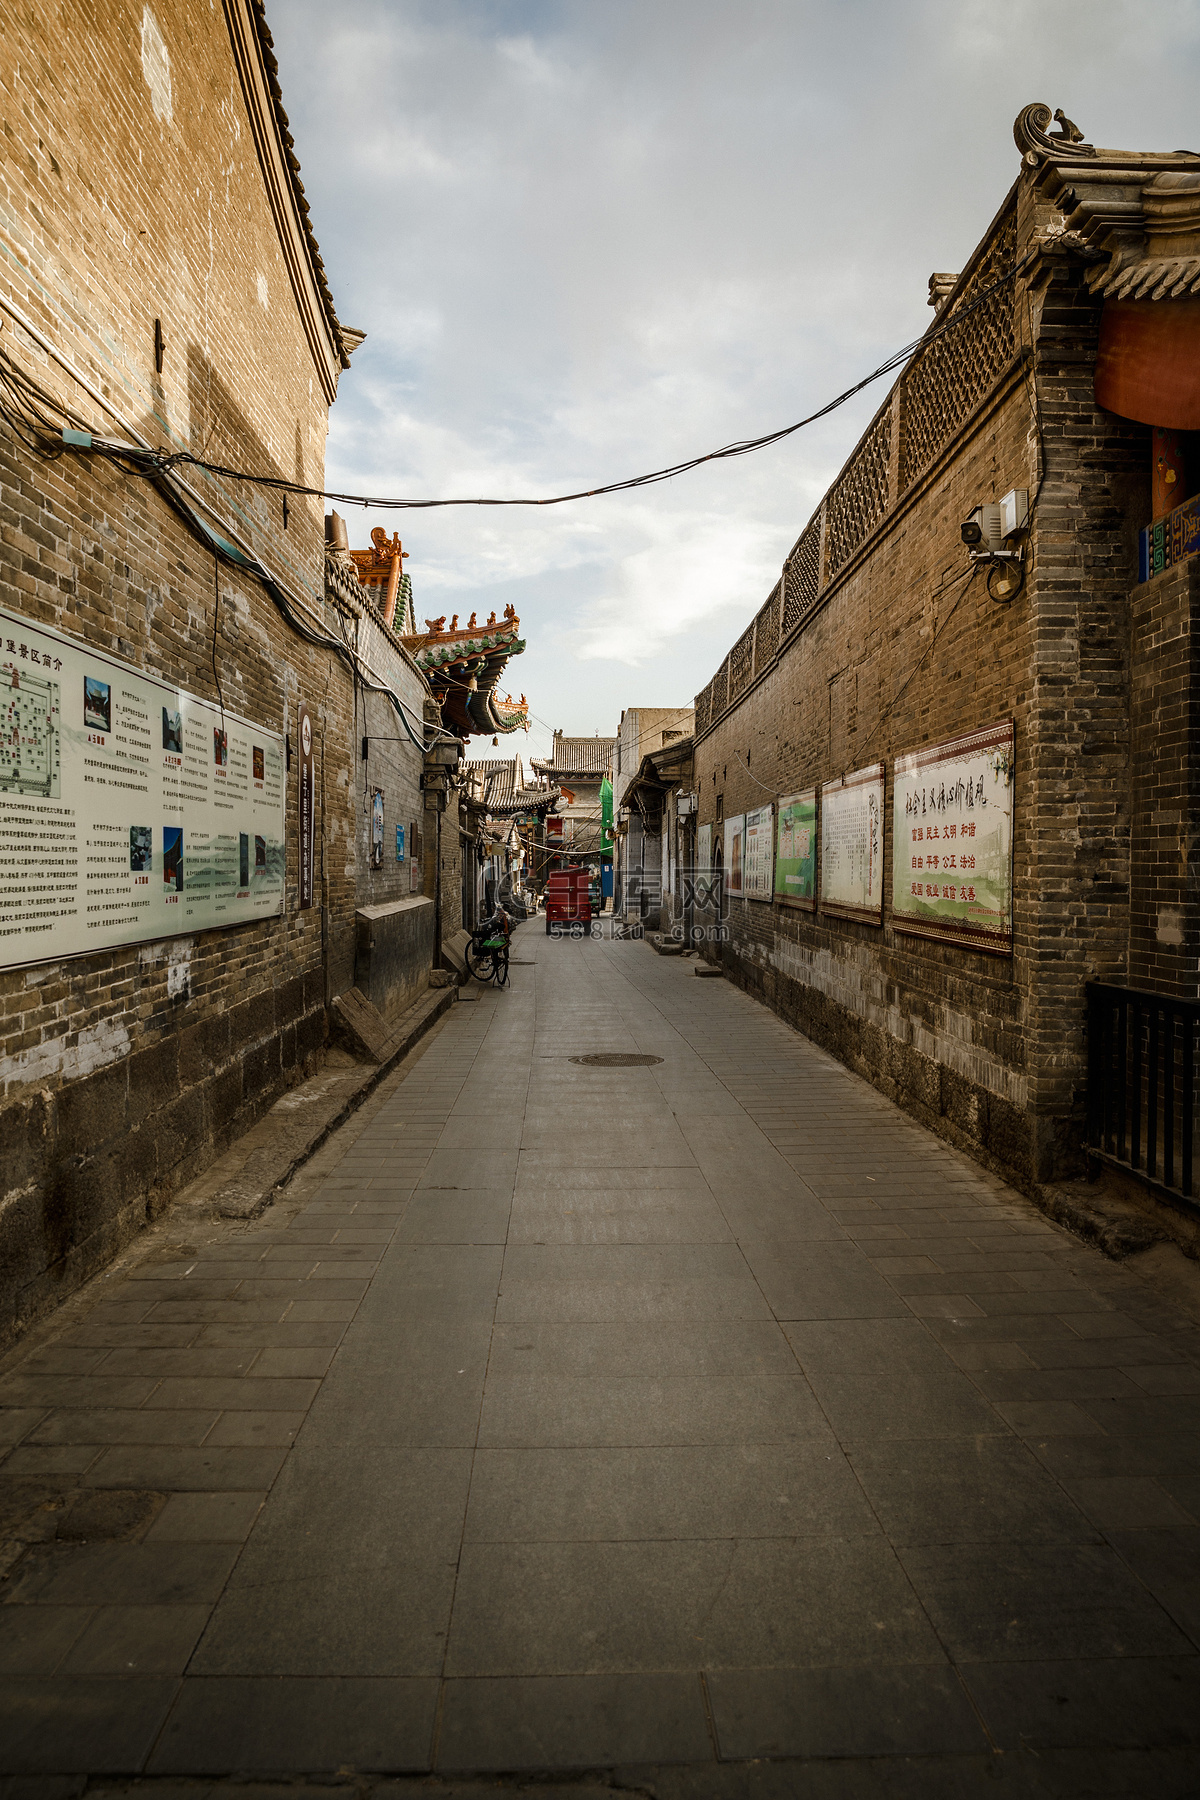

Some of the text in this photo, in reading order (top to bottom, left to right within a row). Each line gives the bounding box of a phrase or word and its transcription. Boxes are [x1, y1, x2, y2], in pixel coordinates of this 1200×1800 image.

[0, 638, 63, 672] 堡景区简介
[905, 775, 987, 815] 社会主义核心价值观
[911, 821, 977, 842] 富强 民主 文明 和谐
[911, 854, 976, 869] 自由 平等 公正 法治
[910, 882, 976, 901] 爱国 敬业 诚信 友善
